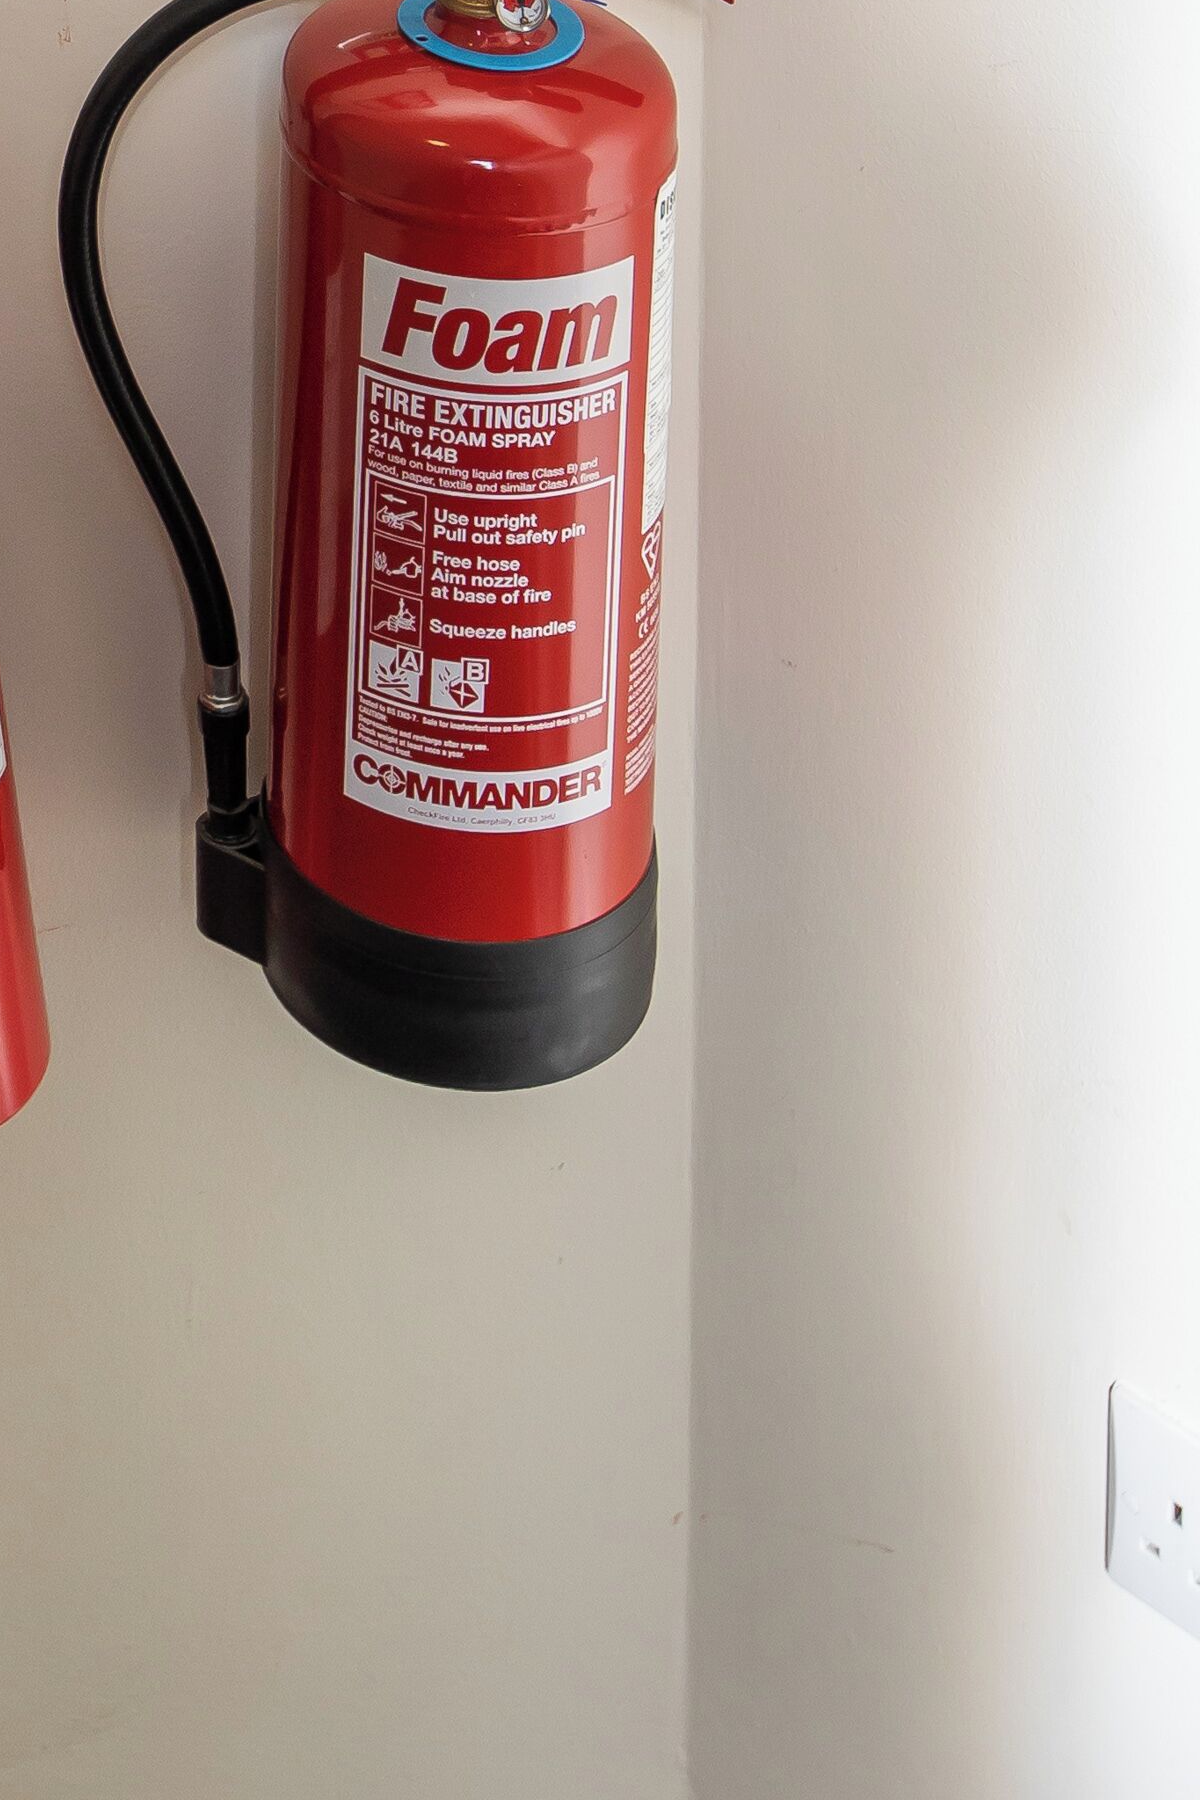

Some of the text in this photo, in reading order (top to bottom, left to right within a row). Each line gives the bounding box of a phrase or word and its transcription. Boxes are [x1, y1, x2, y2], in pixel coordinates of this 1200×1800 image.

[381, 276, 618, 374] Foam
[371, 381, 616, 429] FIRE EXTINGUISHER
[369, 409, 556, 448] 6 Litre FOAM SPRAY
[369, 428, 458, 464] 21A 144B
[368, 444, 599, 481] For use on burning liquid fires (Class B) and
[367, 458, 600, 493] wood, paper, textile and similar Class A fires
[433, 507, 538, 532] Use upright
[433, 522, 586, 545] Pull out safety pin
[432, 550, 521, 571] Free hose
[431, 567, 529, 588] Aim nozzle
[431, 585, 552, 605] at base of fire
[429, 618, 577, 640] Squeeze handles
[400, 651, 420, 672] A
[466, 662, 484, 681] B
[353, 753, 602, 810] COMMANDER
